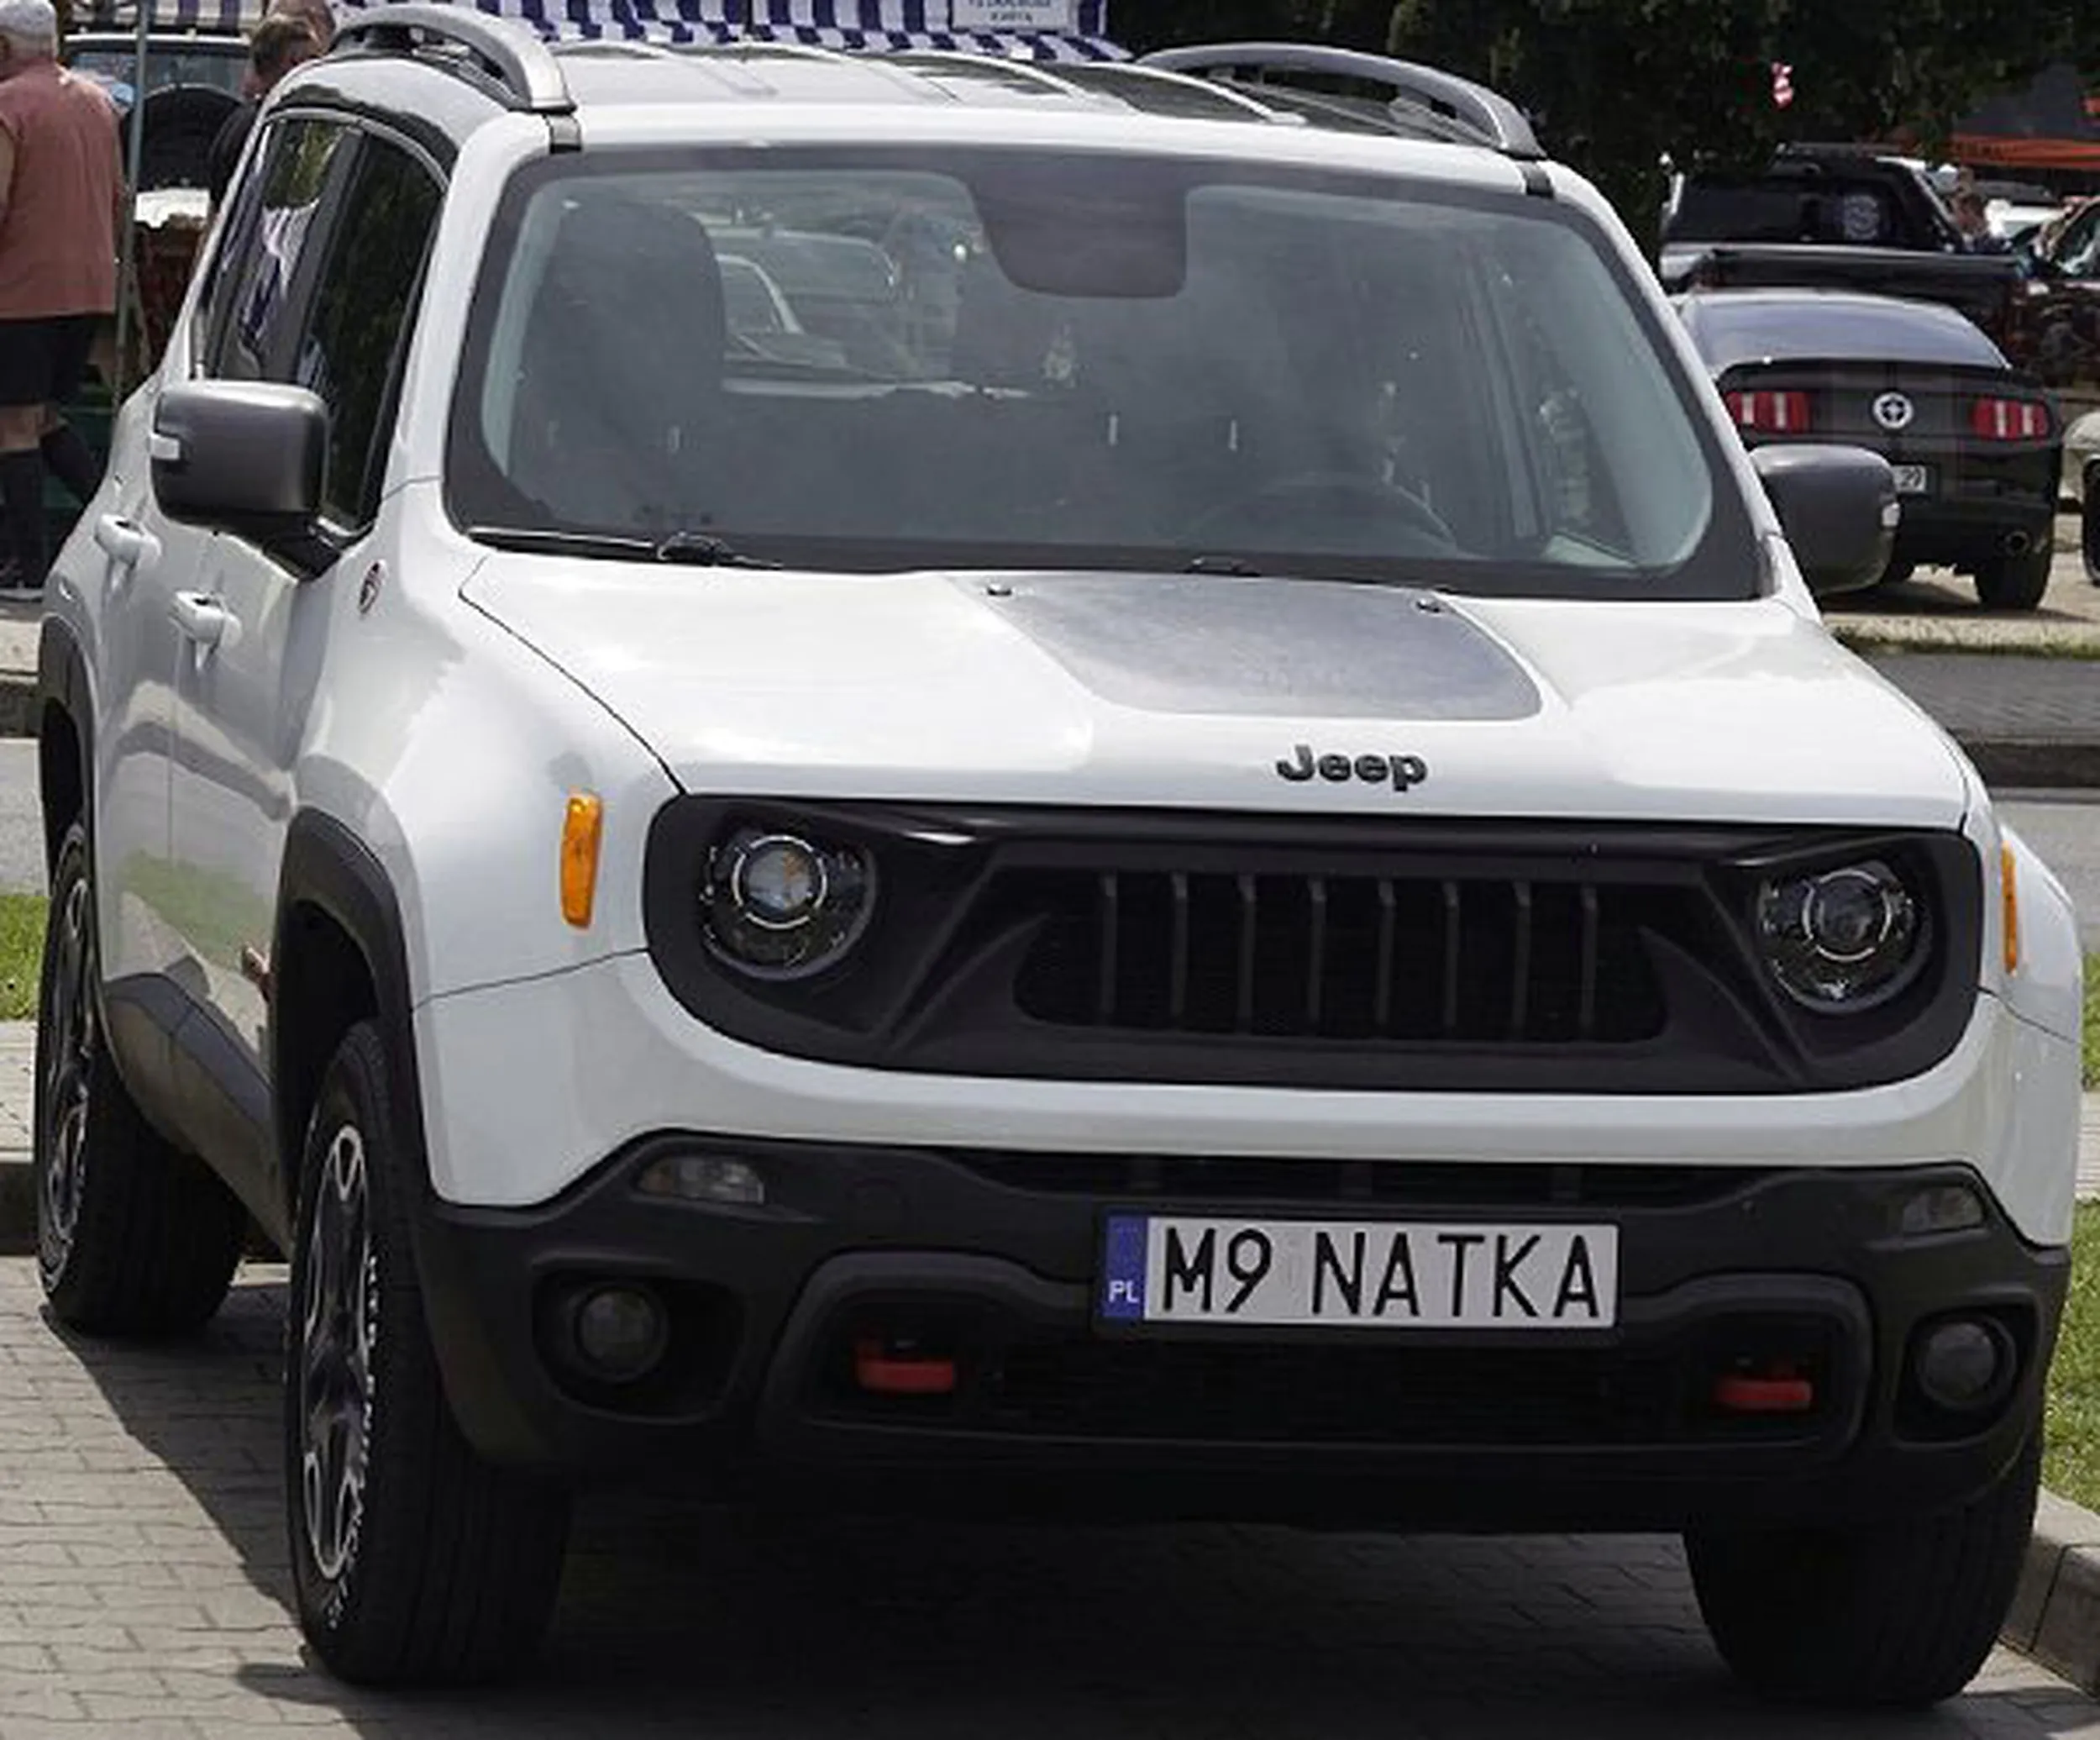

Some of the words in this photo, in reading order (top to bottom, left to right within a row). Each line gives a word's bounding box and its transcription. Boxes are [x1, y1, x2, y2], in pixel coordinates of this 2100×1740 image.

[1276, 744, 1427, 791] Jeep
[1109, 1280, 1141, 1302] PL
[1163, 1227, 1271, 1312] M9
[1312, 1232, 1599, 1317] NATKA
